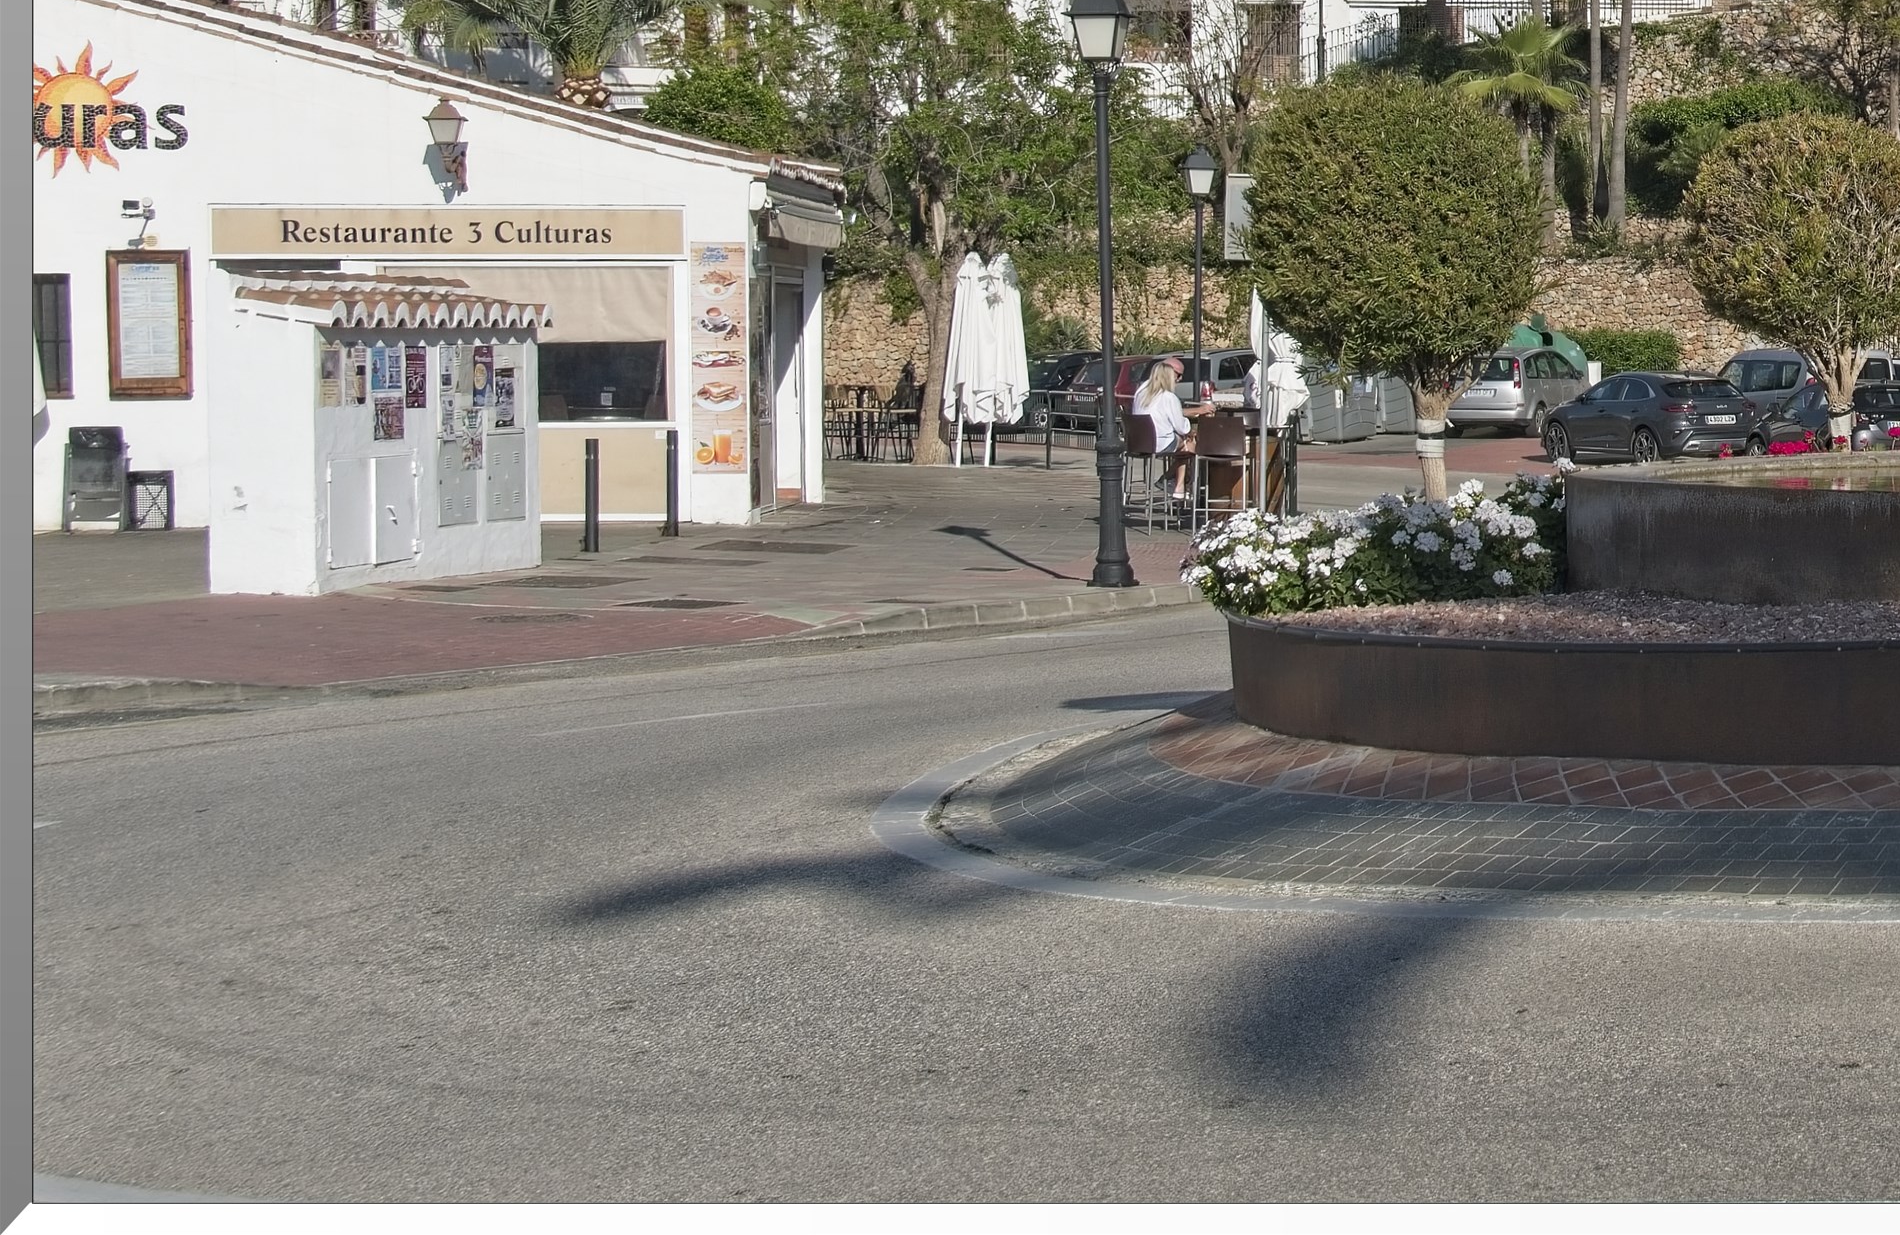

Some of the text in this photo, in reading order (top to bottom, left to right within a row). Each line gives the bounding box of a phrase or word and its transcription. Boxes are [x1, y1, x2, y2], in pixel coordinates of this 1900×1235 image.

[33, 103, 189, 151] uras
[281, 219, 613, 244] Restaurante 3 Culturas
